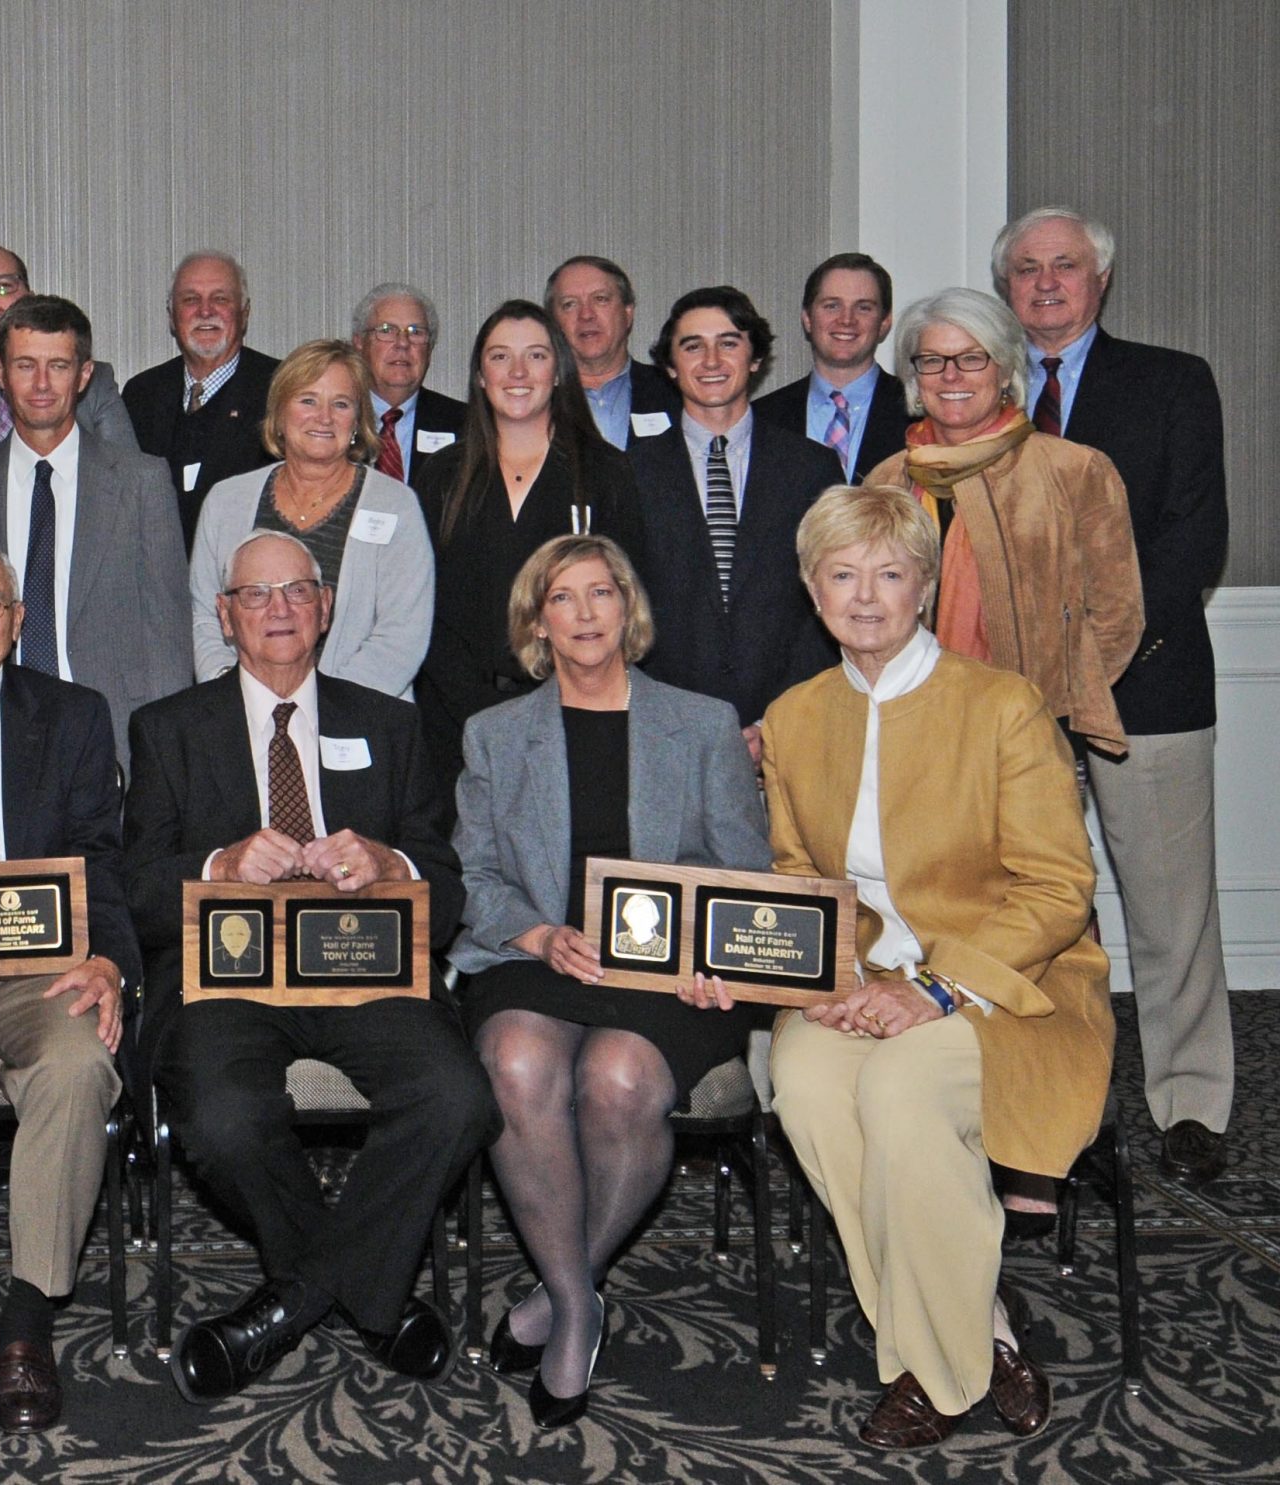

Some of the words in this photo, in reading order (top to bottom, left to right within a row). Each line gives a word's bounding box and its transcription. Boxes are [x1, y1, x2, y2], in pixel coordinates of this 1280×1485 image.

[2, 916, 12, 925] of
[13, 916, 36, 924] Fame
[735, 934, 754, 944] Hall
[754, 936, 766, 944] of
[767, 937, 794, 947] Fame
[323, 942, 339, 950] Hall
[340, 942, 350, 950] of
[322, 952, 348, 960] TONY
[350, 952, 376, 960] LOCH
[724, 943, 756, 956] DANA
[758, 946, 804, 960] HARRITY
